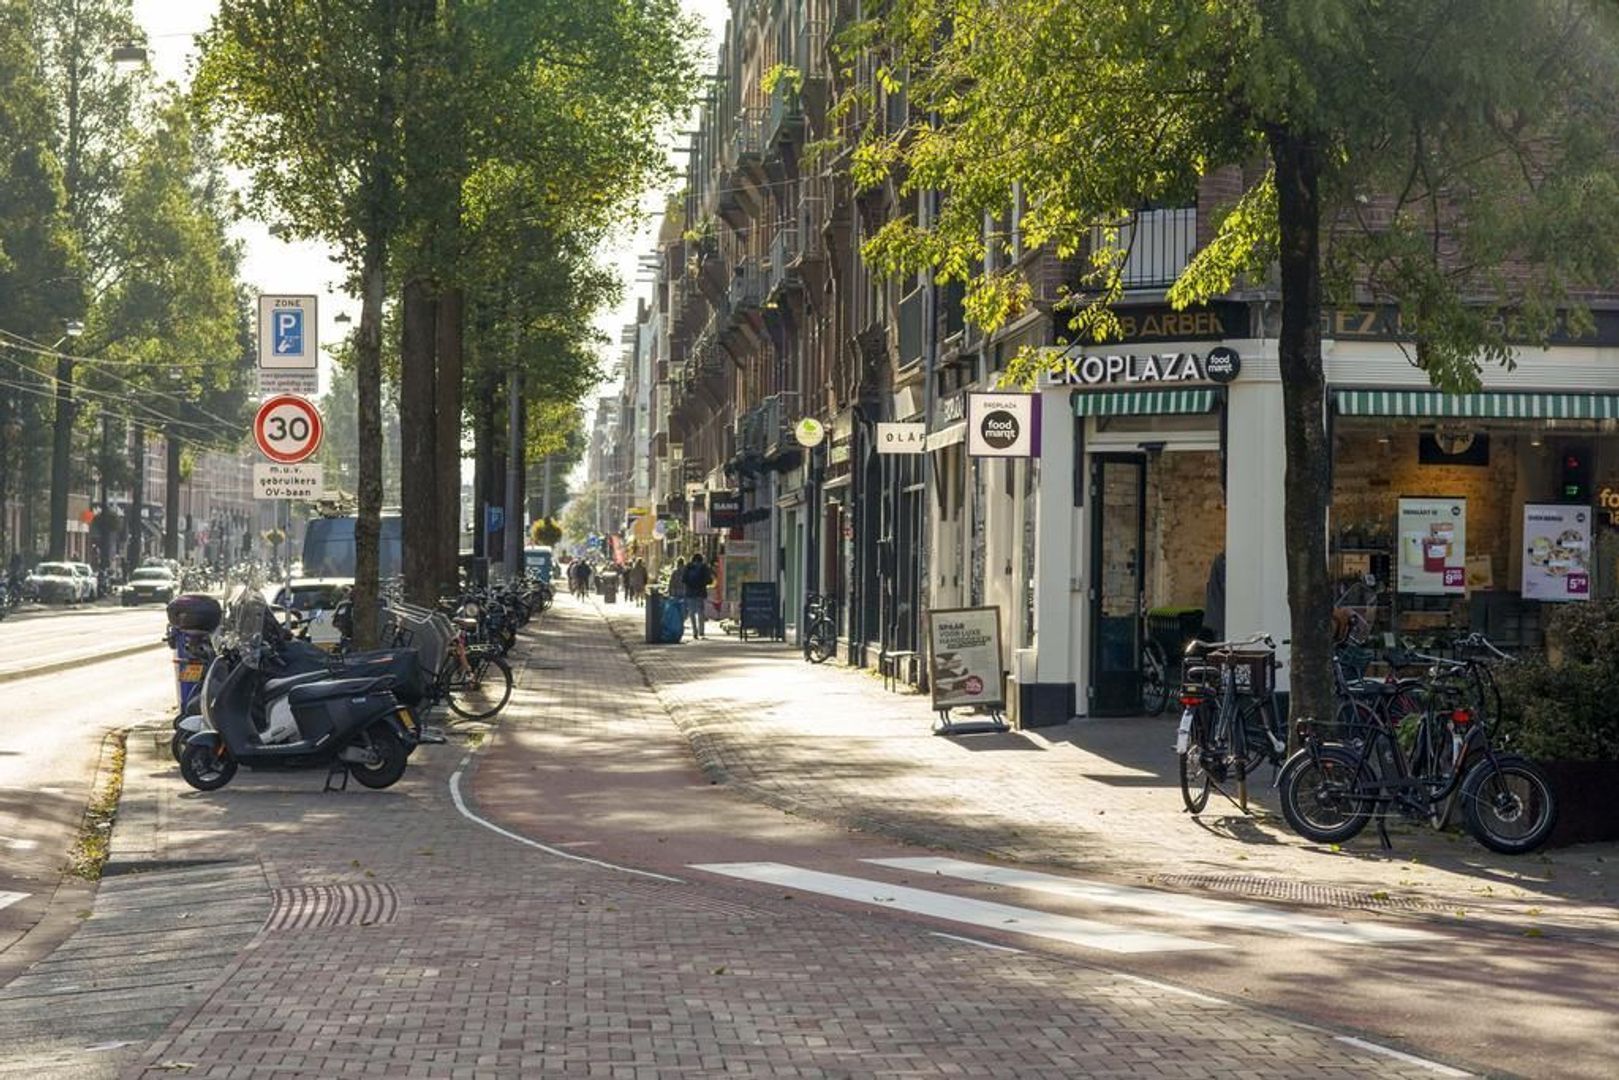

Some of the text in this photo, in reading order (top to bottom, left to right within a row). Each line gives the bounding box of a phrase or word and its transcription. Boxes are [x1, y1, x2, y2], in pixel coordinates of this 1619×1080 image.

[275, 299, 301, 307] ZONE
[279, 314, 296, 336] P
[1211, 354, 1230, 364] food
[1208, 363, 1233, 374] marqt
[268, 416, 309, 441] 30
[988, 419, 1012, 430] food
[886, 432, 926, 443] OLAF
[985, 429, 1016, 441] marqt
[259, 477, 317, 487] gebruikers
[265, 488, 312, 497] OV-baan
